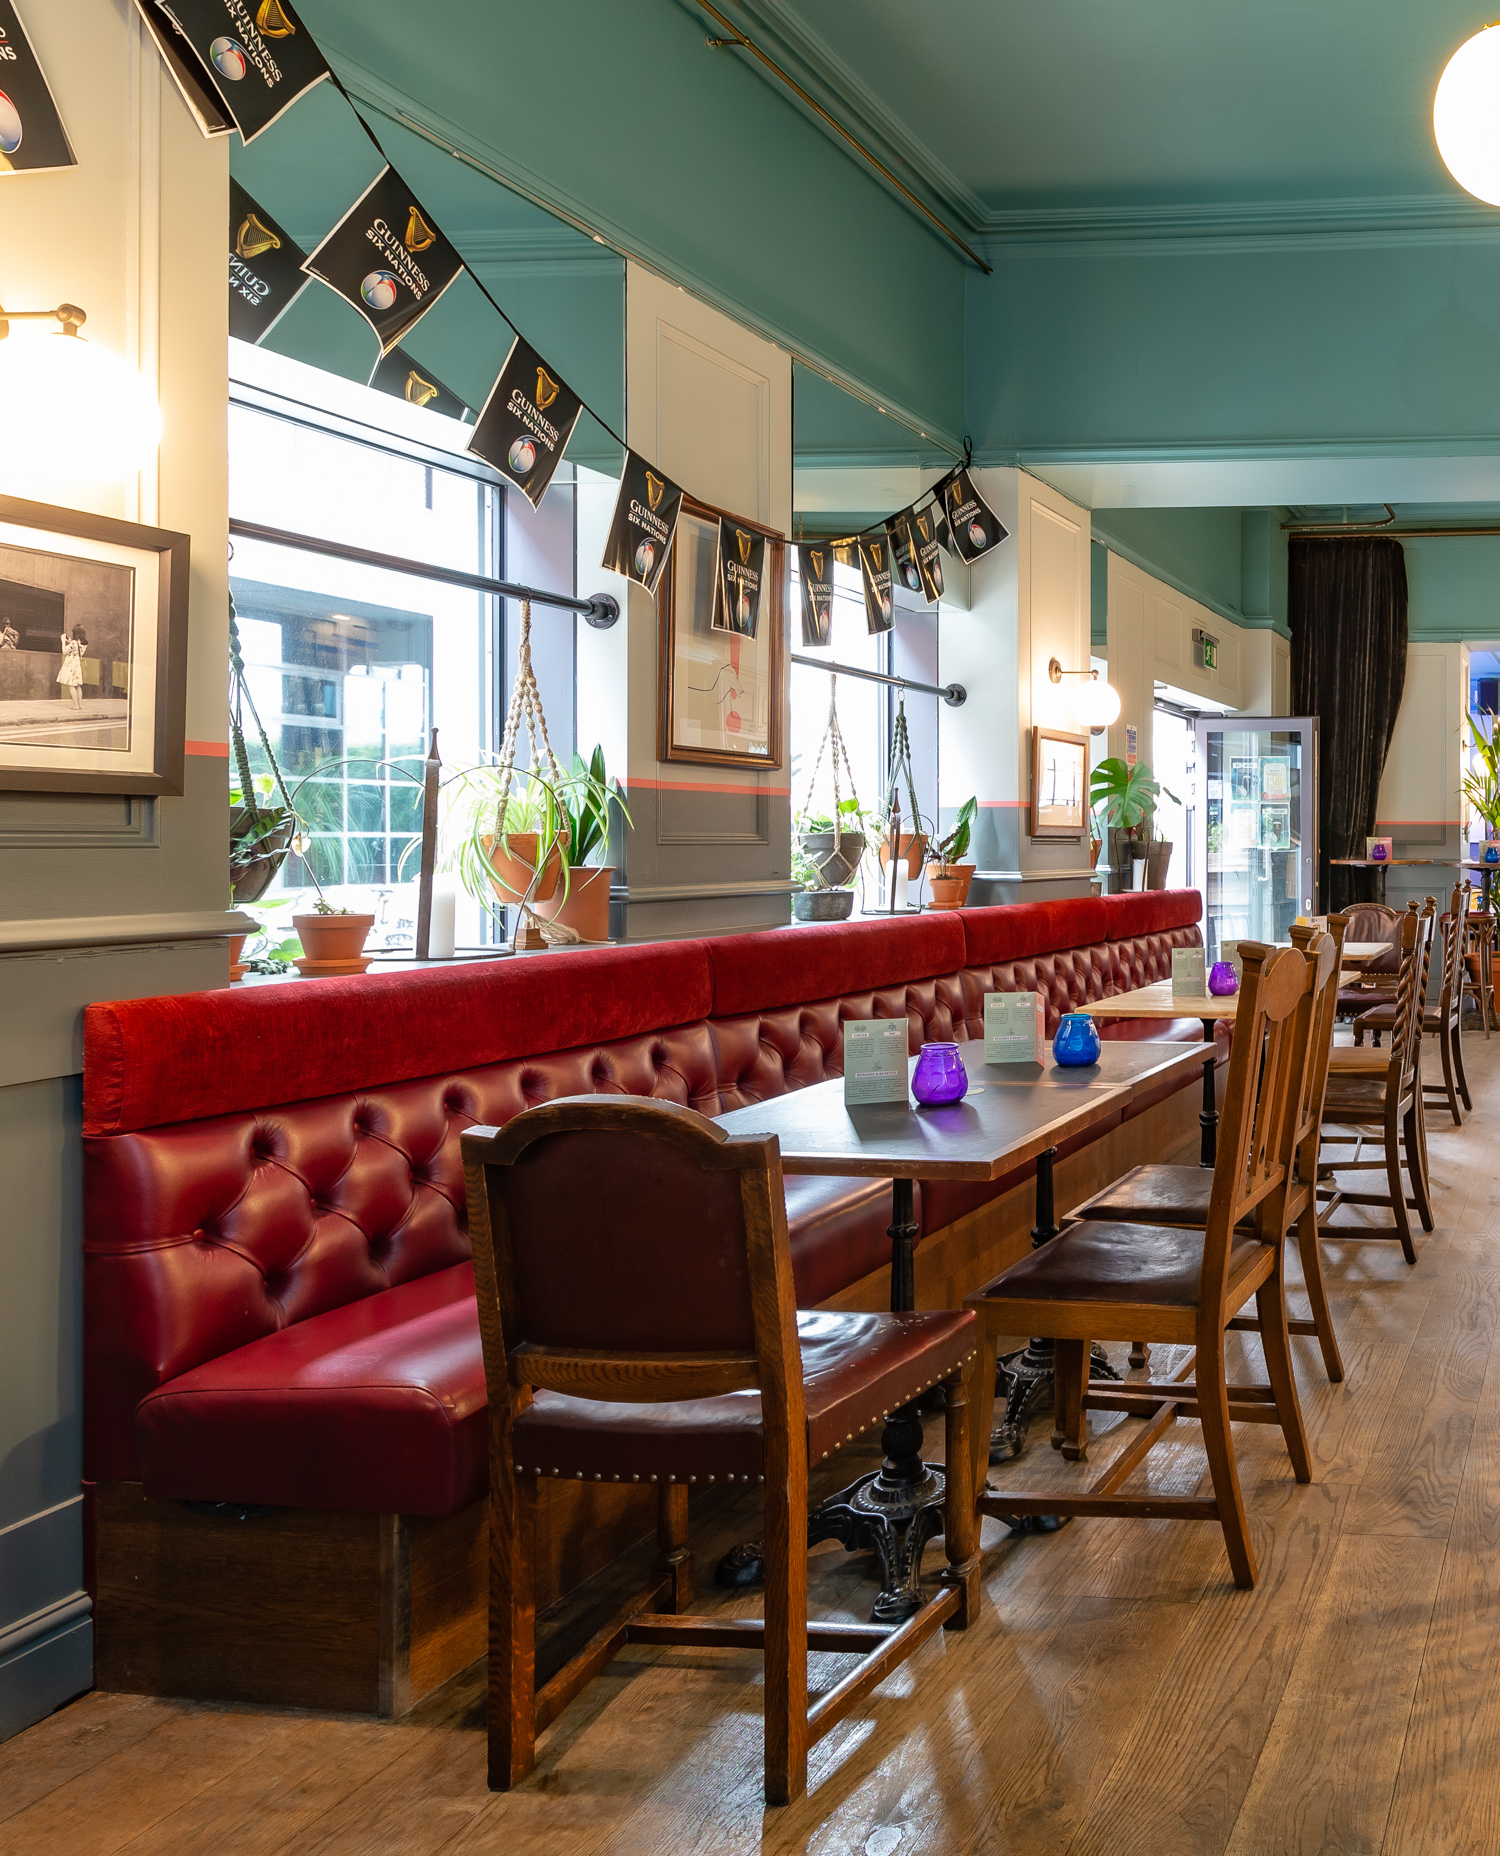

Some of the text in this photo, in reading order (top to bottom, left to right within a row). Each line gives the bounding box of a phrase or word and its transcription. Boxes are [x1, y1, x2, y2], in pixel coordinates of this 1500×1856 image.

[234, 0, 283, 82] UINNESS
[235, 20, 274, 88] NATIONS
[365, 229, 423, 300] SIX NATIONS
[373, 218, 430, 292] GUINNESS
[507, 402, 555, 452] SIX NATIONS
[512, 389, 560, 442] GUINNESS
[627, 513, 667, 545] SIX NATIONS
[630, 499, 669, 535] GUINNESS
[952, 500, 977, 520] GUINNESS
[960, 507, 981, 523] NATIONS
[727, 560, 759, 582] GUINNESS
